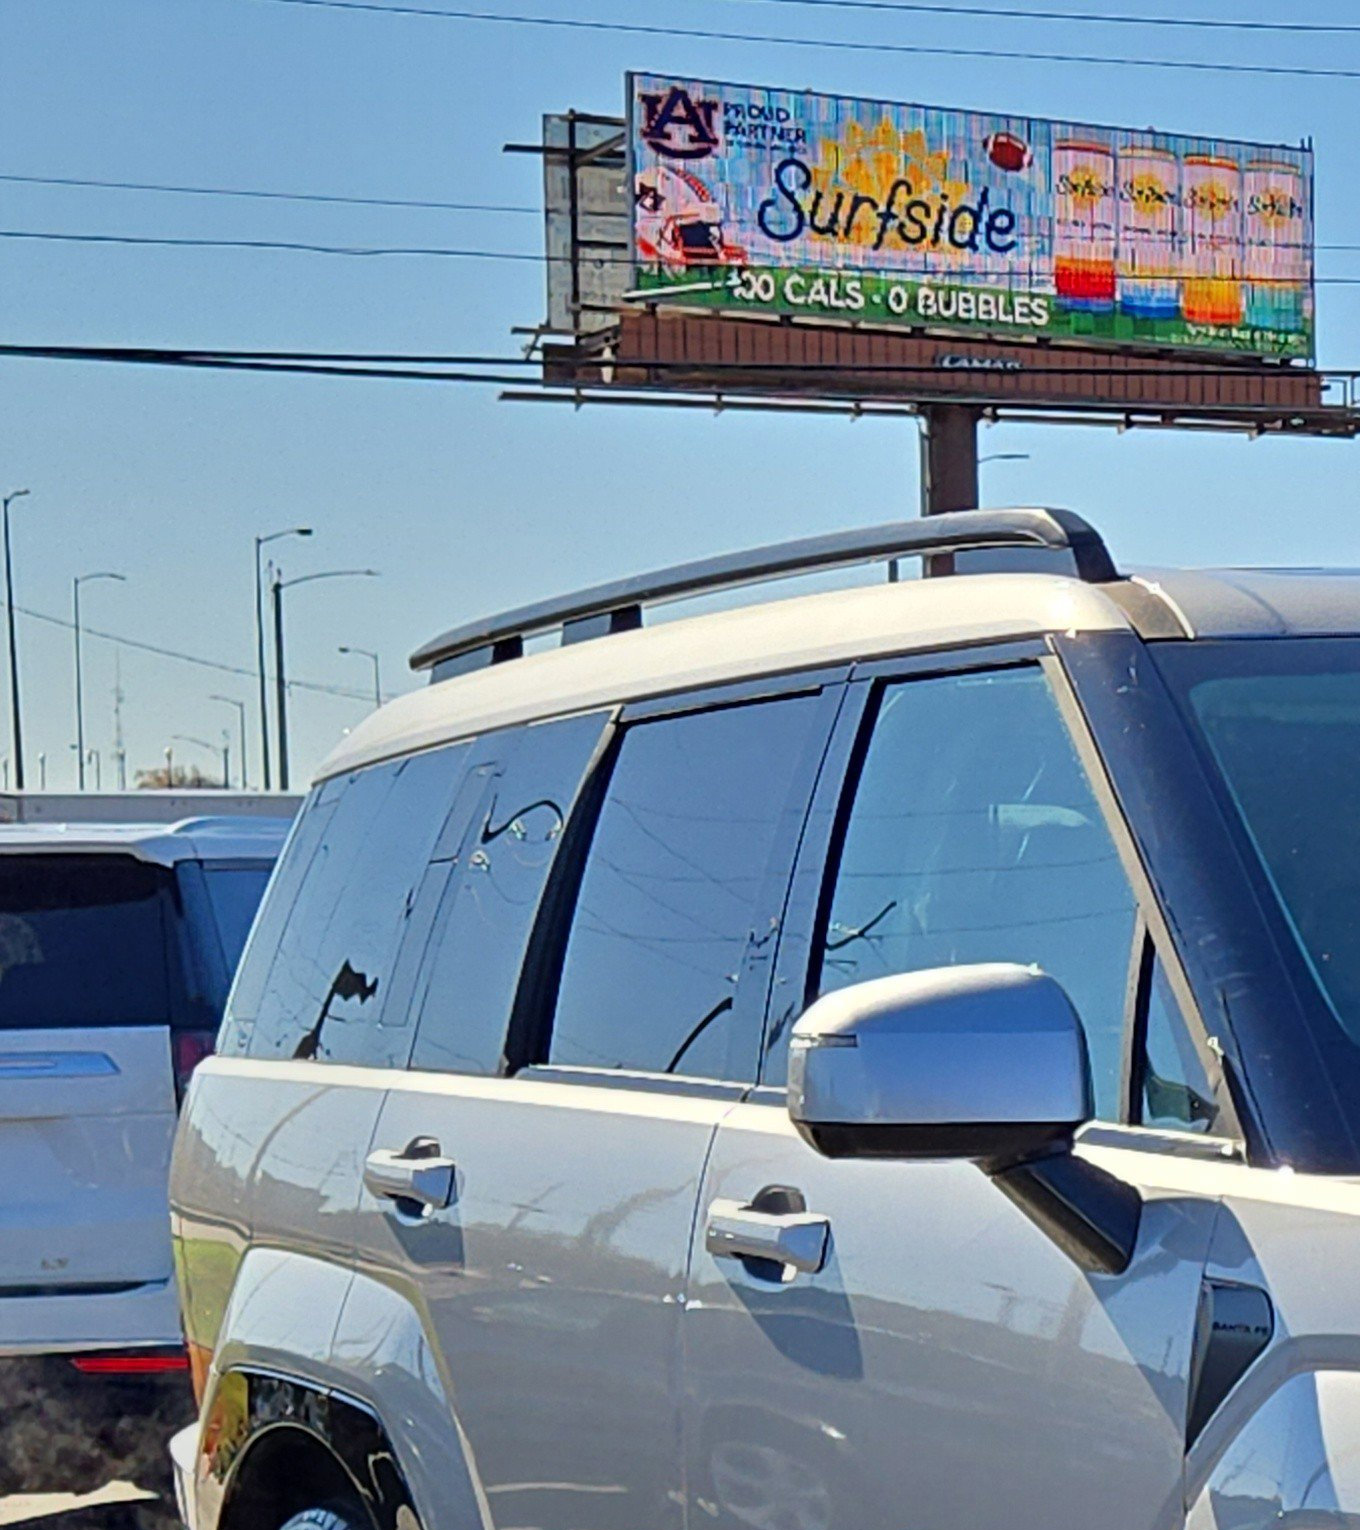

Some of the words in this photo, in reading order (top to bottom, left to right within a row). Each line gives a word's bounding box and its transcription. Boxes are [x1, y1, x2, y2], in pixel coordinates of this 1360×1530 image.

[723, 101, 791, 124] PROUD
[723, 120, 807, 145] PARTNER
[757, 157, 1018, 253] Surfside
[783, 272, 866, 311] CALS
[916, 287, 1050, 327] BUBBLES
